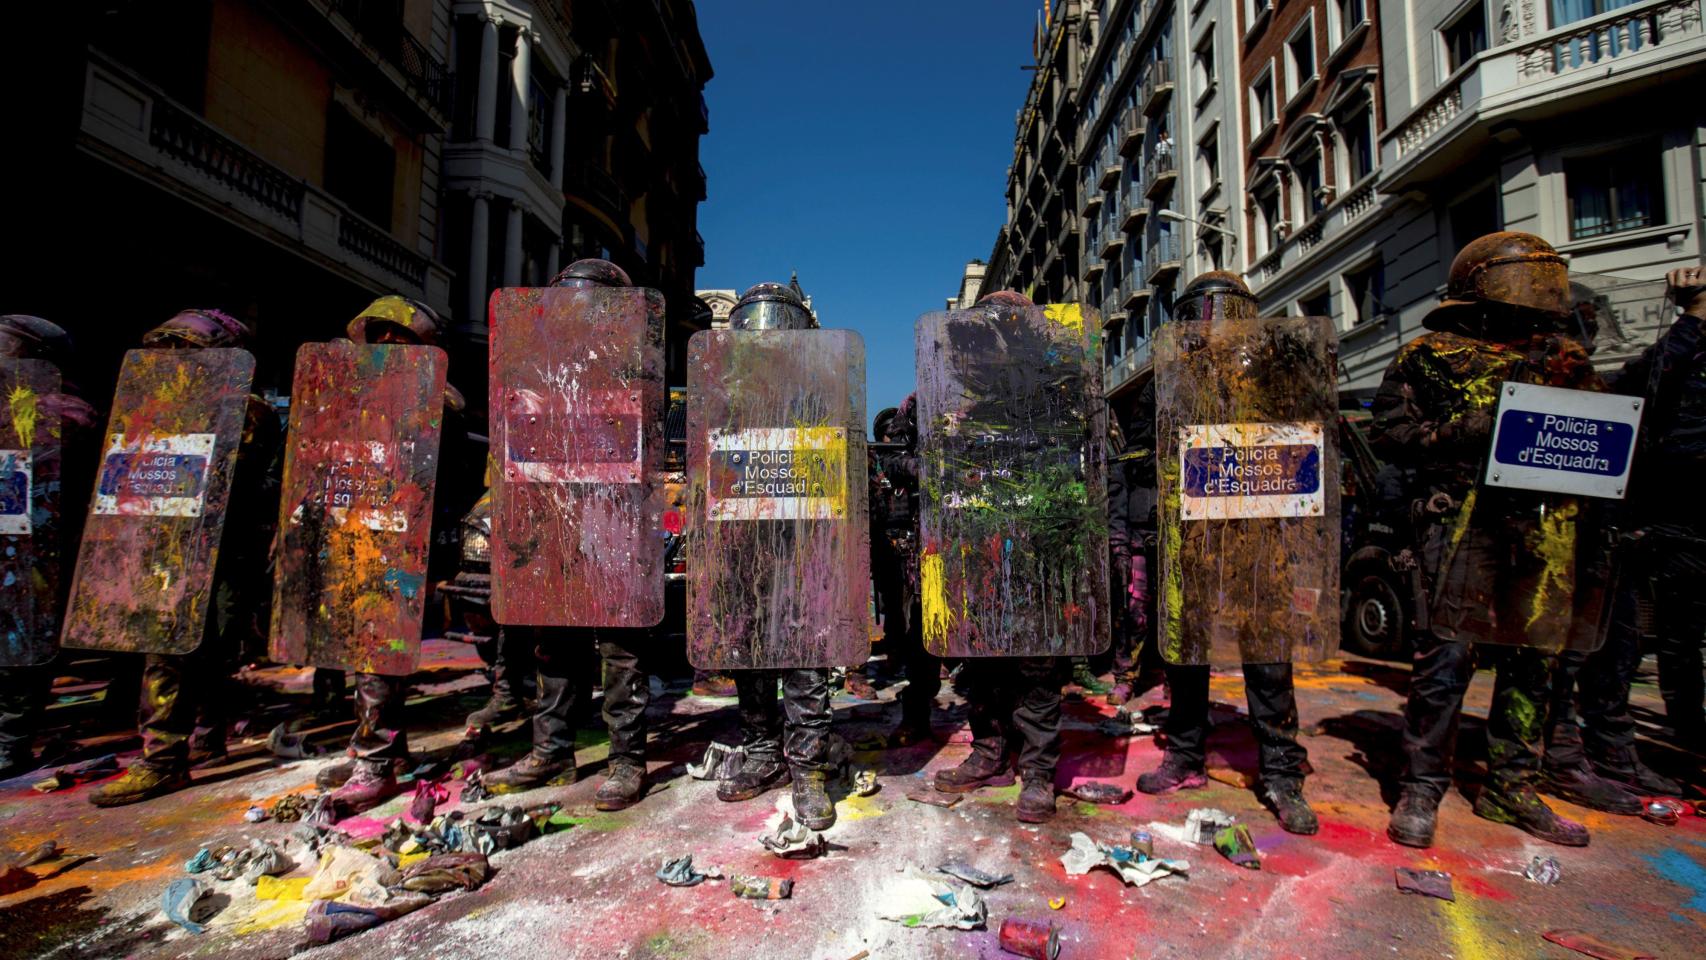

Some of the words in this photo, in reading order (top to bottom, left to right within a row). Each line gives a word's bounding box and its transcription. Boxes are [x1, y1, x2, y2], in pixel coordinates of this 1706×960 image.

[1543, 414, 1599, 436] Policia
[1535, 431, 1600, 453] Mossos
[1223, 446, 1278, 462] Policia
[1517, 447, 1610, 471] d'Esquadra
[1218, 462, 1284, 477] Mossos
